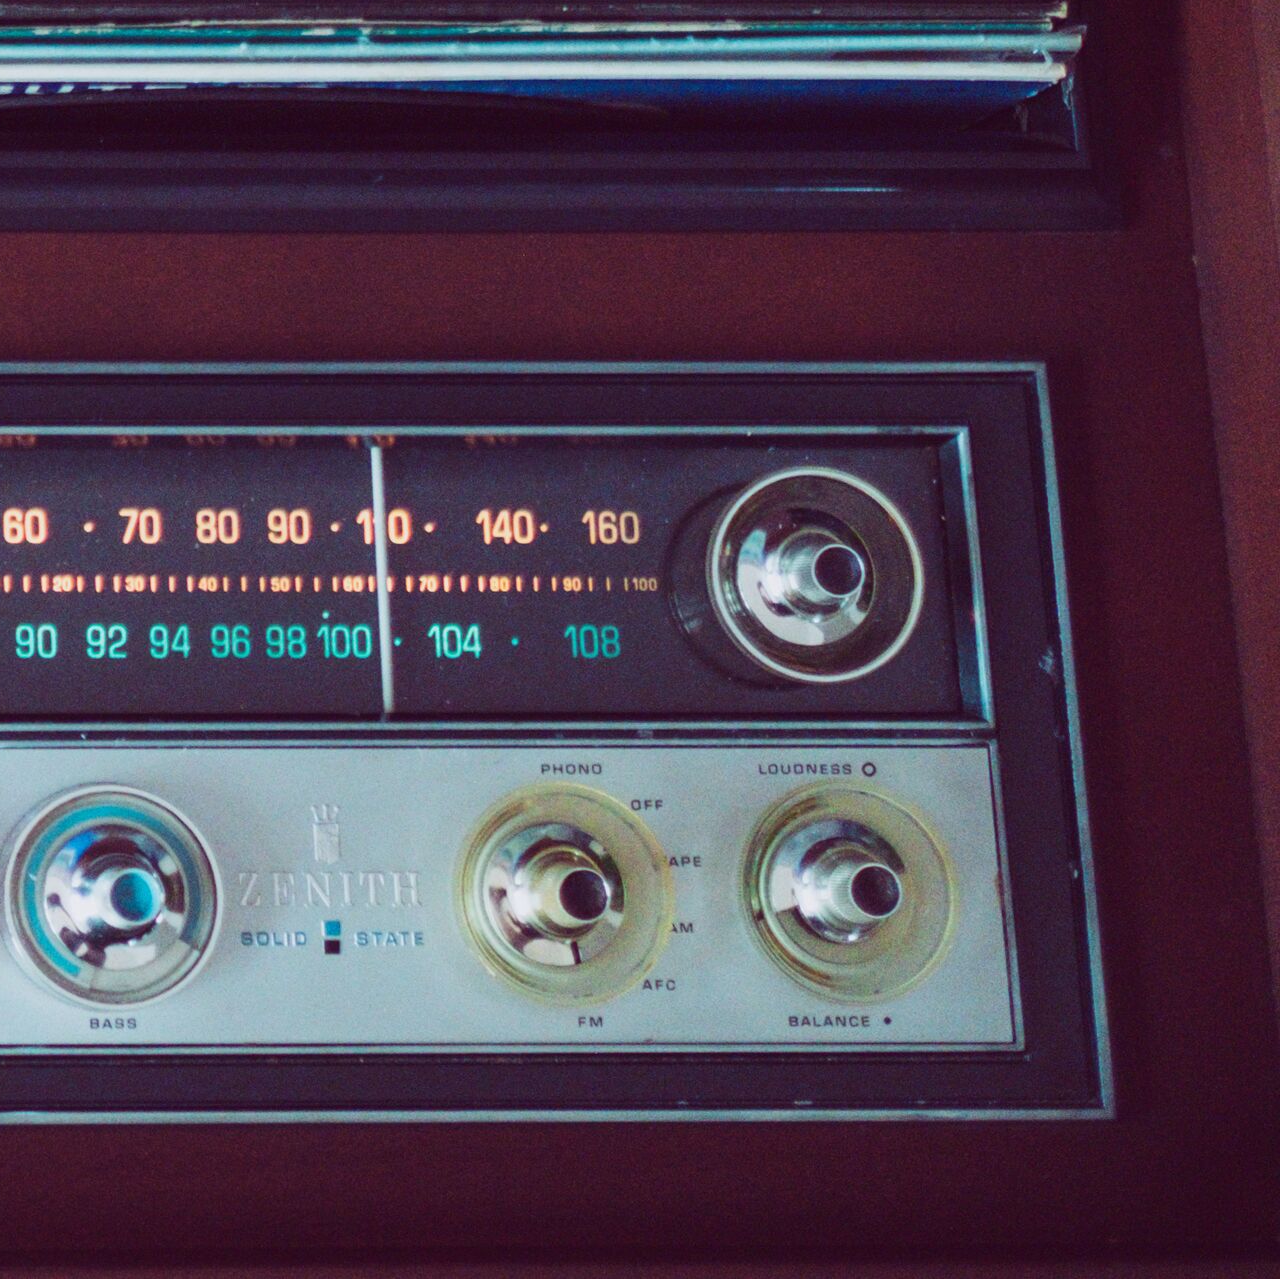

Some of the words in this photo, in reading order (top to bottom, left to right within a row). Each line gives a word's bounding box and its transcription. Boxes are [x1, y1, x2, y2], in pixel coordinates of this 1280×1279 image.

[1, 508, 49, 545] 60
[118, 508, 163, 545] 70
[195, 508, 240, 545] 80
[267, 508, 311, 545] 90
[356, 508, 412, 545] 10
[476, 508, 535, 545] 140
[581, 508, 641, 545] 160
[52, 577, 74, 592] 20
[124, 577, 144, 592] 30
[198, 577, 218, 592] 40
[270, 577, 290, 592] 50
[419, 577, 438, 592] 70
[562, 577, 582, 592] 90
[632, 577, 657, 592] 100
[14, 624, 58, 660] 90
[85, 624, 128, 660] 92
[149, 624, 191, 660] 94
[210, 624, 251, 660] 96
[266, 624, 307, 660] 98
[317, 624, 372, 660] 100
[428, 624, 482, 660] 104
[564, 624, 621, 660] 108
[541, 763, 602, 776] PHONO
[758, 763, 852, 776] LOUDNESS
[630, 799, 665, 811] OFF
[663, 856, 702, 868] APE
[239, 870, 424, 909] ZENITH
[241, 931, 307, 947] SOLID
[355, 931, 425, 947] STATE
[642, 979, 677, 992] AFC
[90, 1017, 138, 1031] BASS
[577, 1017, 603, 1028] FM
[788, 1015, 870, 1028] BALANCE
